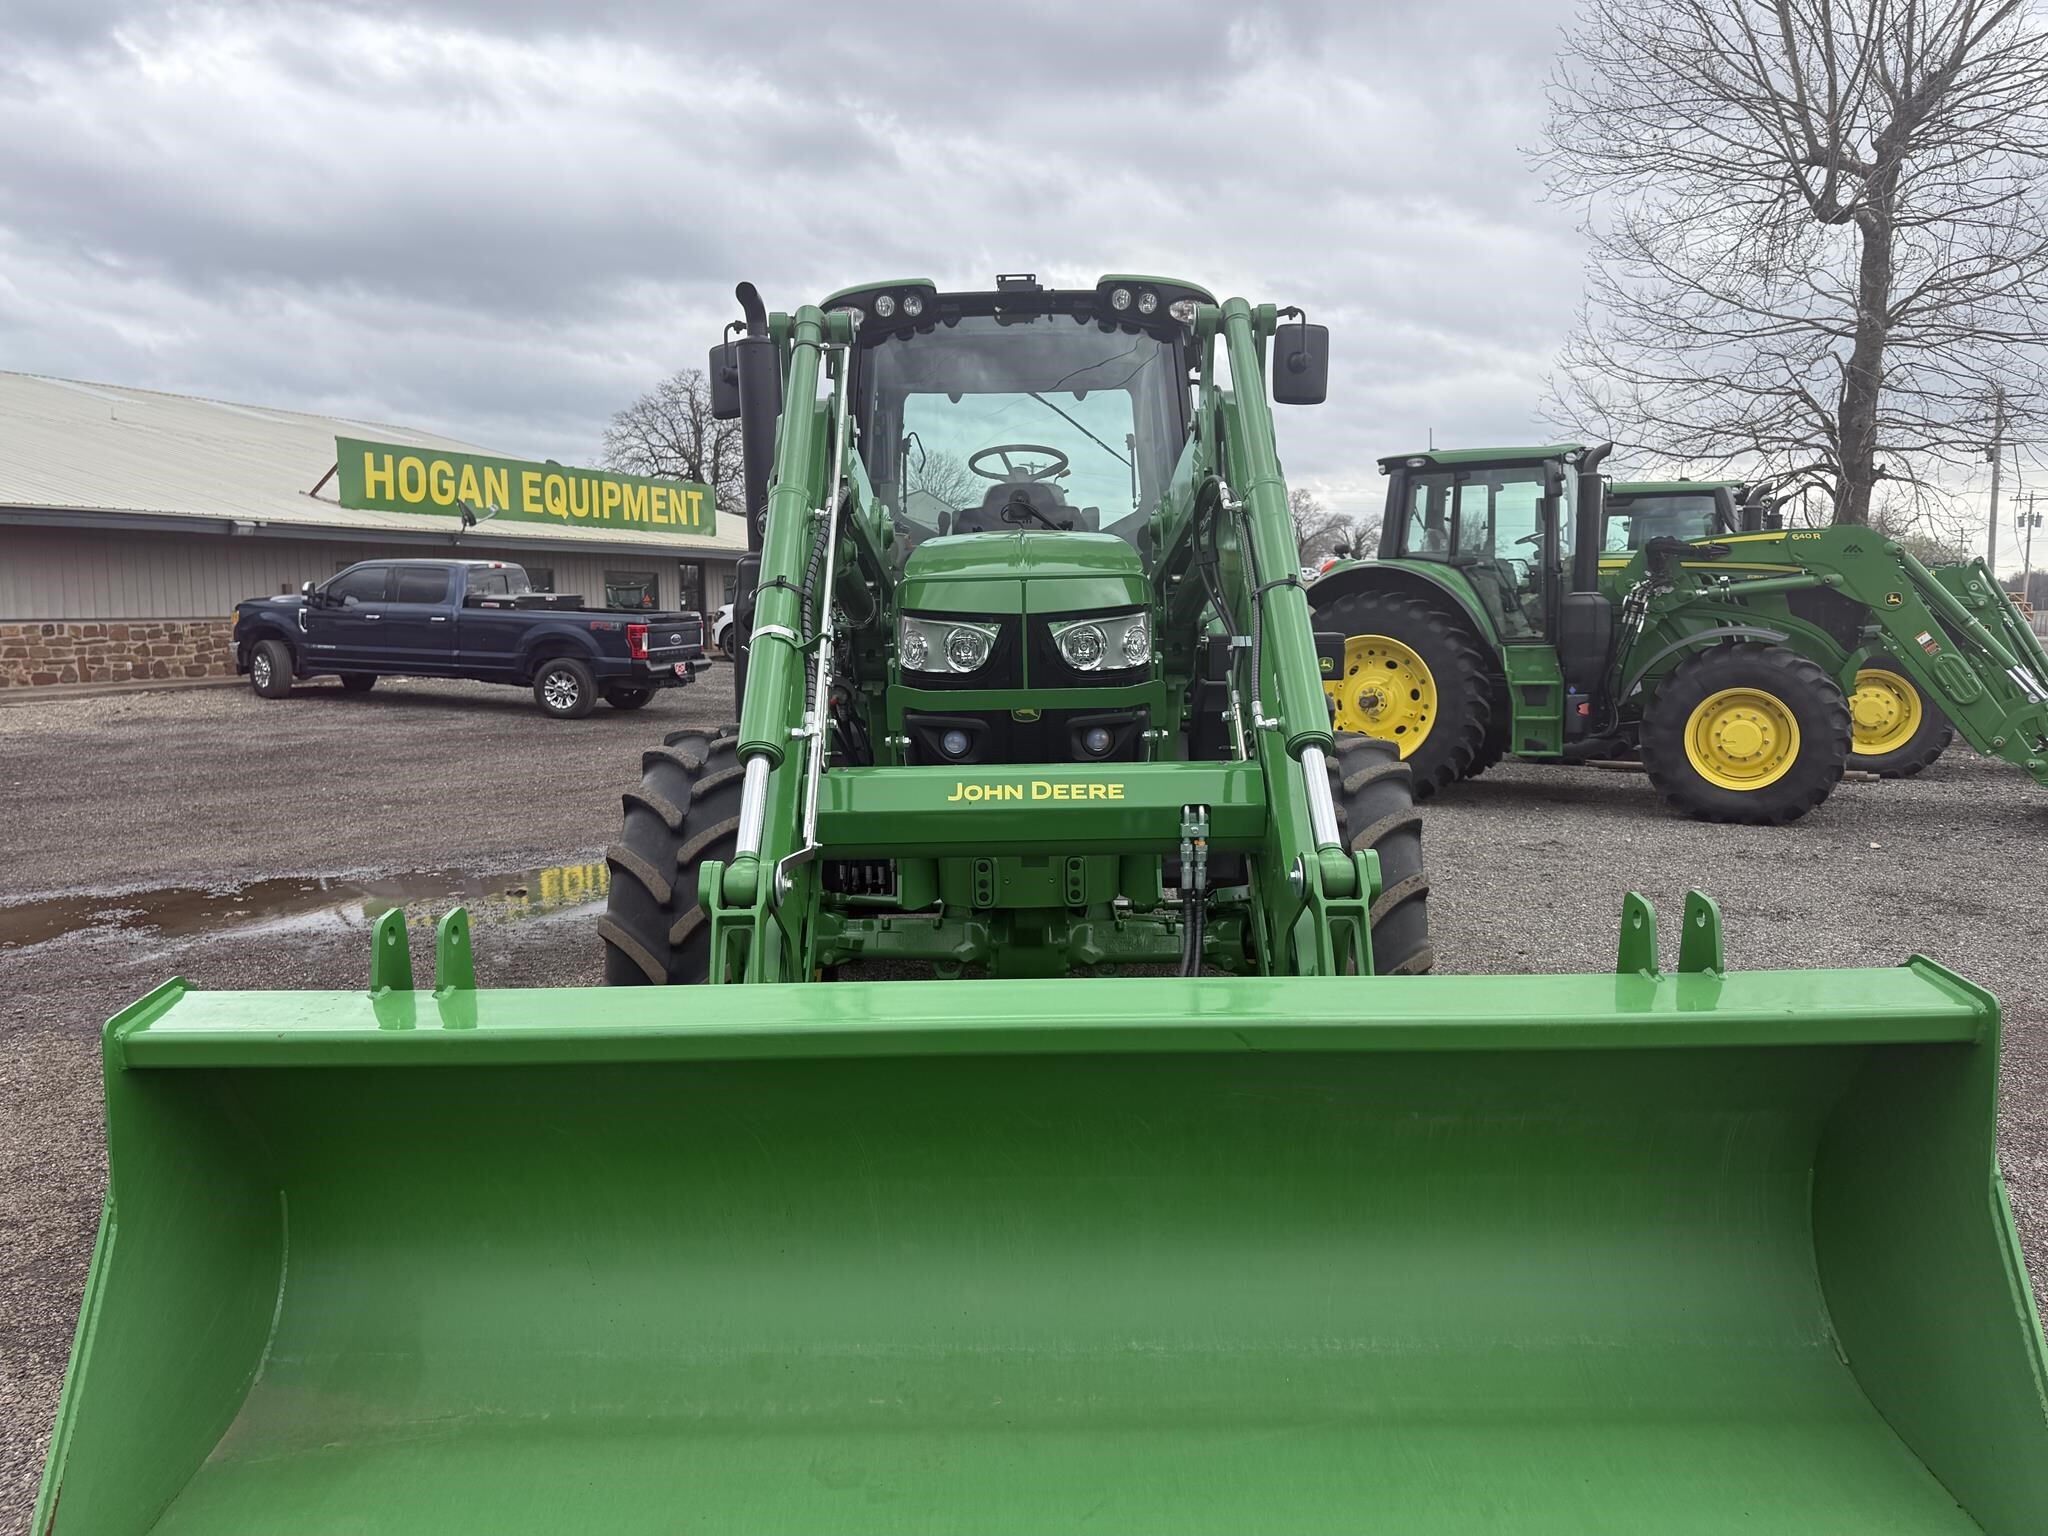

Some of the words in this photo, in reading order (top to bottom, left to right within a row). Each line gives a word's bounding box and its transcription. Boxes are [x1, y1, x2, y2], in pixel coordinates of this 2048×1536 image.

[363, 451, 510, 511] HOGAN
[521, 470, 704, 527] EQUIPMENT
[947, 782, 1024, 801] JOHN
[1031, 781, 1125, 801] DEERE
